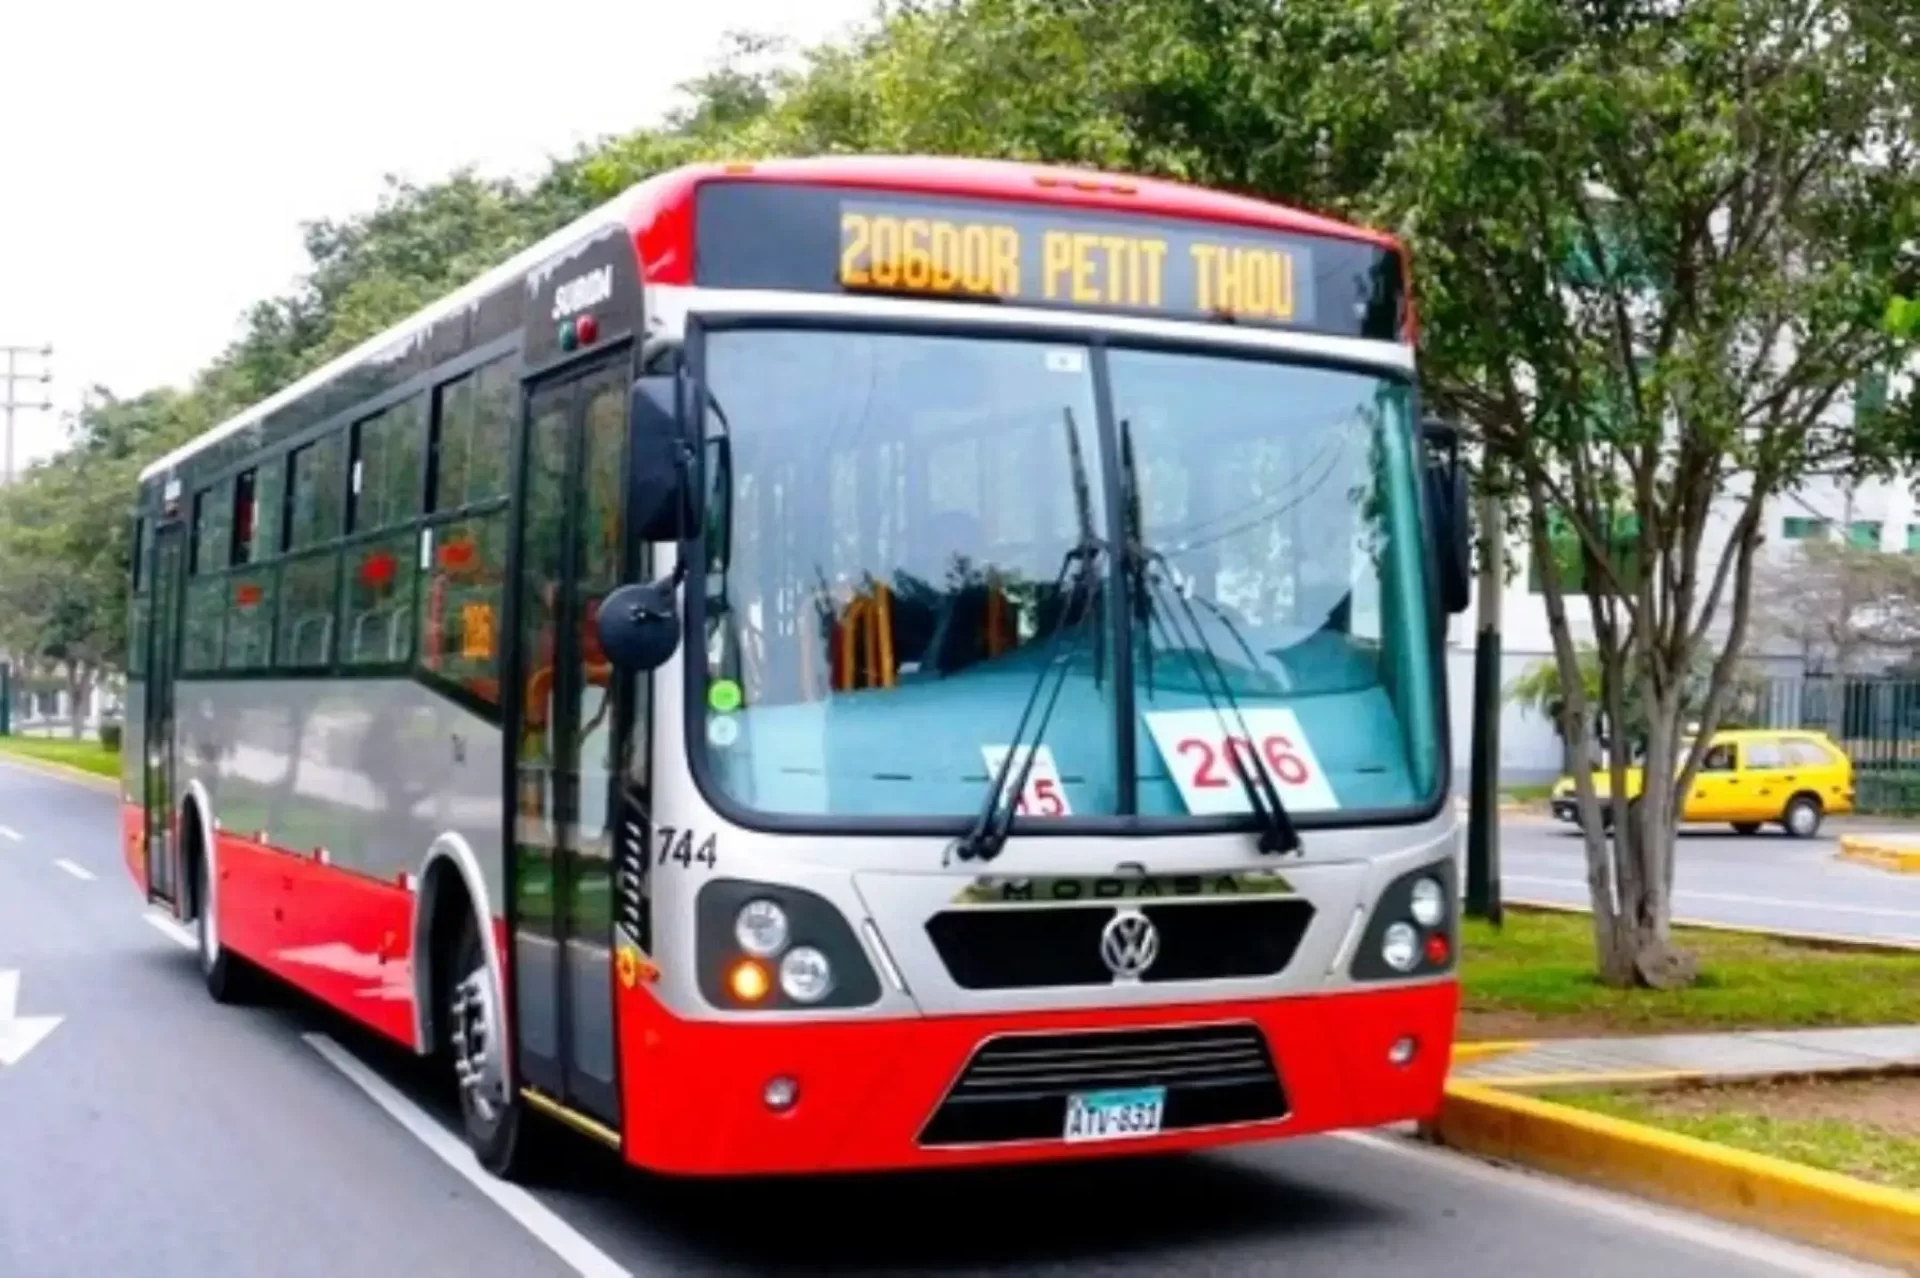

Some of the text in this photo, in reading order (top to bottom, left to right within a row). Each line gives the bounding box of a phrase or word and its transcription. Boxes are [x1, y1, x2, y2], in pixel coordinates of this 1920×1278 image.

[1043, 230, 1167, 306] PETIT
[1190, 243, 1296, 322] THOU
[1176, 736, 1309, 788] 206
[658, 827, 717, 869] 744
[1003, 875, 1239, 900] MODASA
